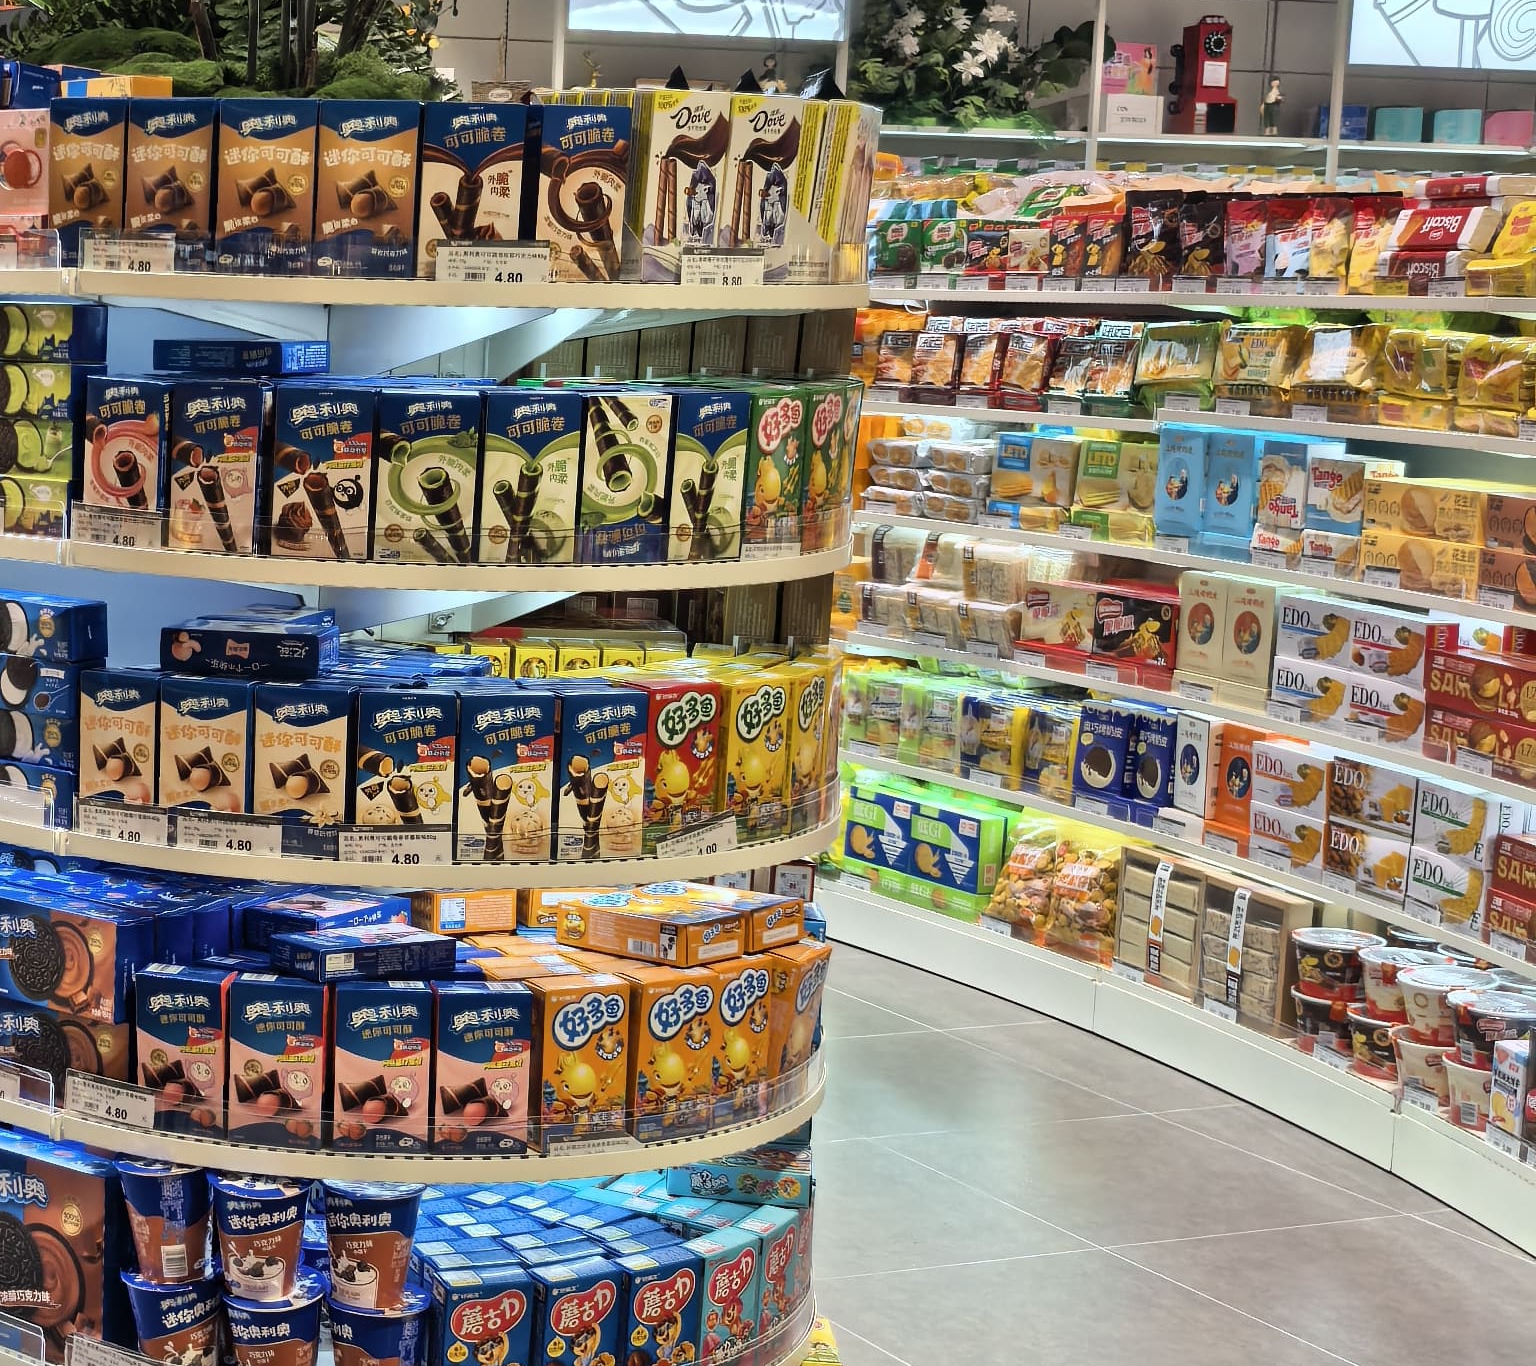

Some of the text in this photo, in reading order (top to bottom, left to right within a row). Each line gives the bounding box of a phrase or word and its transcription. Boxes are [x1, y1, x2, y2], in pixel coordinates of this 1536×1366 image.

[451, 113, 497, 130] 奥利奥
[670, 107, 713, 130] Dove
[749, 110, 786, 133] Dove
[443, 126, 507, 148] 可可脆卷
[559, 128, 615, 150] 可可脆卷
[1421, 216, 1463, 233] Biscoff
[128, 261, 151, 272] 4.80
[495, 273, 523, 283] 4.80
[185, 396, 247, 416] 奥利奥
[291, 402, 360, 425] 奥利奥
[407, 401, 453, 416] 奥利奥
[513, 403, 557, 420] 奥利奥
[194, 415, 242, 434] 可可脆卷
[300, 422, 353, 440] 可可脆卷
[400, 414, 462, 434] 可可脆卷
[506, 417, 565, 438] 可可脆卷
[760, 402, 802, 447] 好多鱼
[1311, 467, 1344, 490] Tango
[112, 535, 135, 547] 4.80
[1256, 533, 1281, 549] Tango
[1309, 540, 1334, 556] Tango
[1282, 606, 1311, 628] EDO
[1354, 620, 1383, 642] EDO
[1276, 667, 1306, 688] EDO
[178, 696, 230, 715] 奥利奥
[801, 679, 824, 720] 好多鱼
[1350, 685, 1380, 708] EDO
[274, 703, 329, 724] 奥利奥
[374, 706, 444, 731] 奥利奥
[474, 705, 543, 731] 奥利奥
[576, 705, 637, 731] 奥利奥
[662, 695, 715, 740] 好多鱼
[741, 688, 784, 740] 好多鱼
[383, 725, 437, 745] 可可脆卷
[484, 725, 536, 745] 可可脆卷
[1255, 753, 1282, 774] EDO
[1334, 765, 1364, 788] EDO
[1421, 791, 1449, 814] EDO
[1253, 812, 1282, 835] EDO
[118, 830, 141, 842] 4.80
[225, 839, 252, 852] 4.80
[1331, 830, 1360, 852] EDO
[392, 853, 420, 865] 4.80
[1413, 858, 1444, 881] EDO
[149, 994, 211, 1013] 奥利奥
[725, 972, 768, 1017] 好多鱼
[245, 1002, 311, 1022] 奥利奥
[351, 1004, 418, 1027] 奥利奥
[452, 1008, 520, 1031] 奥利奥
[559, 996, 621, 1043] 好多鱼
[655, 989, 712, 1033] 好多鱼
[105, 1106, 128, 1120] 4.80
[228, 1206, 298, 1230] 迷你奥利奥
[714, 1257, 754, 1297] 蘑古力
[642, 1273, 692, 1317] 蘑古力
[459, 1295, 520, 1336] 蘑古力
[559, 1287, 615, 1328] 蘑古力
